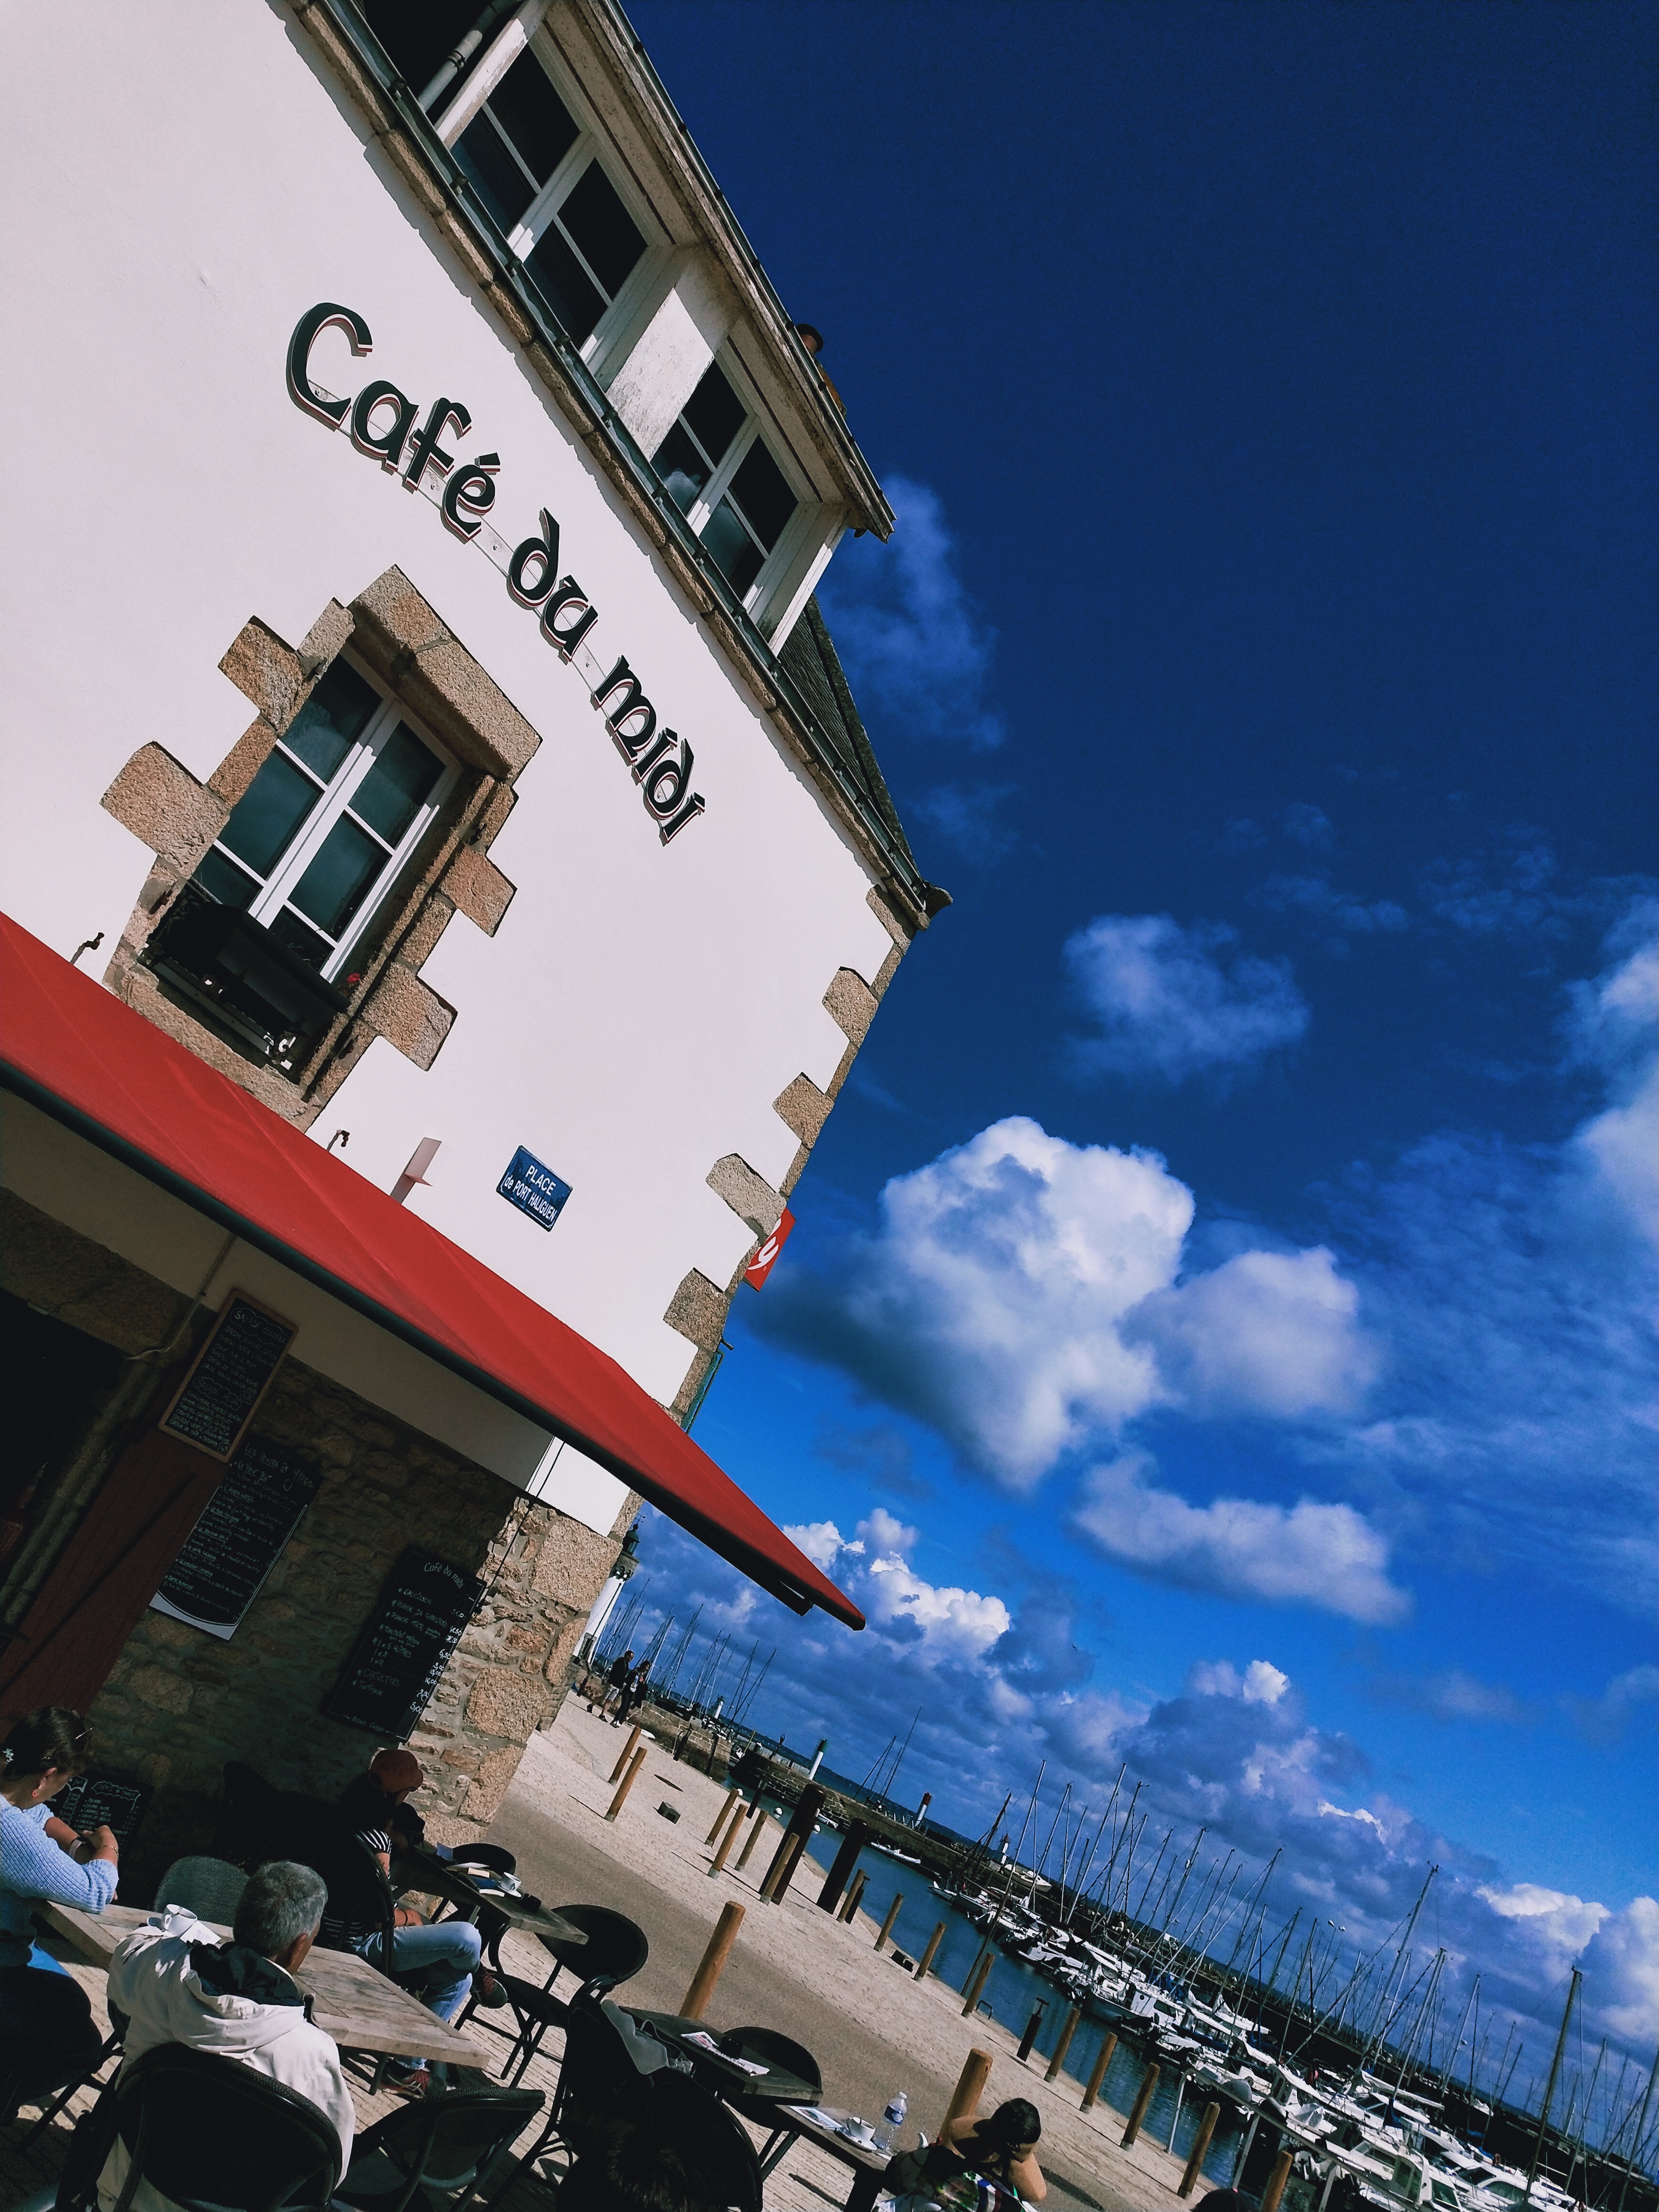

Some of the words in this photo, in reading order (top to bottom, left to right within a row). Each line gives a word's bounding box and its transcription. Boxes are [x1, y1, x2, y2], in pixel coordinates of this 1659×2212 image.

[286, 301, 502, 544] Café
[507, 506, 600, 663] du
[590, 654, 706, 846] midi
[526, 1165, 556, 1196] PLACE
[505, 1175, 514, 1189] de
[513, 1180, 531, 1201] PORT
[528, 1192, 557, 1222] HALIGUEN
[424, 1562, 443, 1572] Café
[443, 1565, 452, 1576] du
[452, 1574, 464, 1589] midi
[410, 1701, 423, 1714] 5,00
